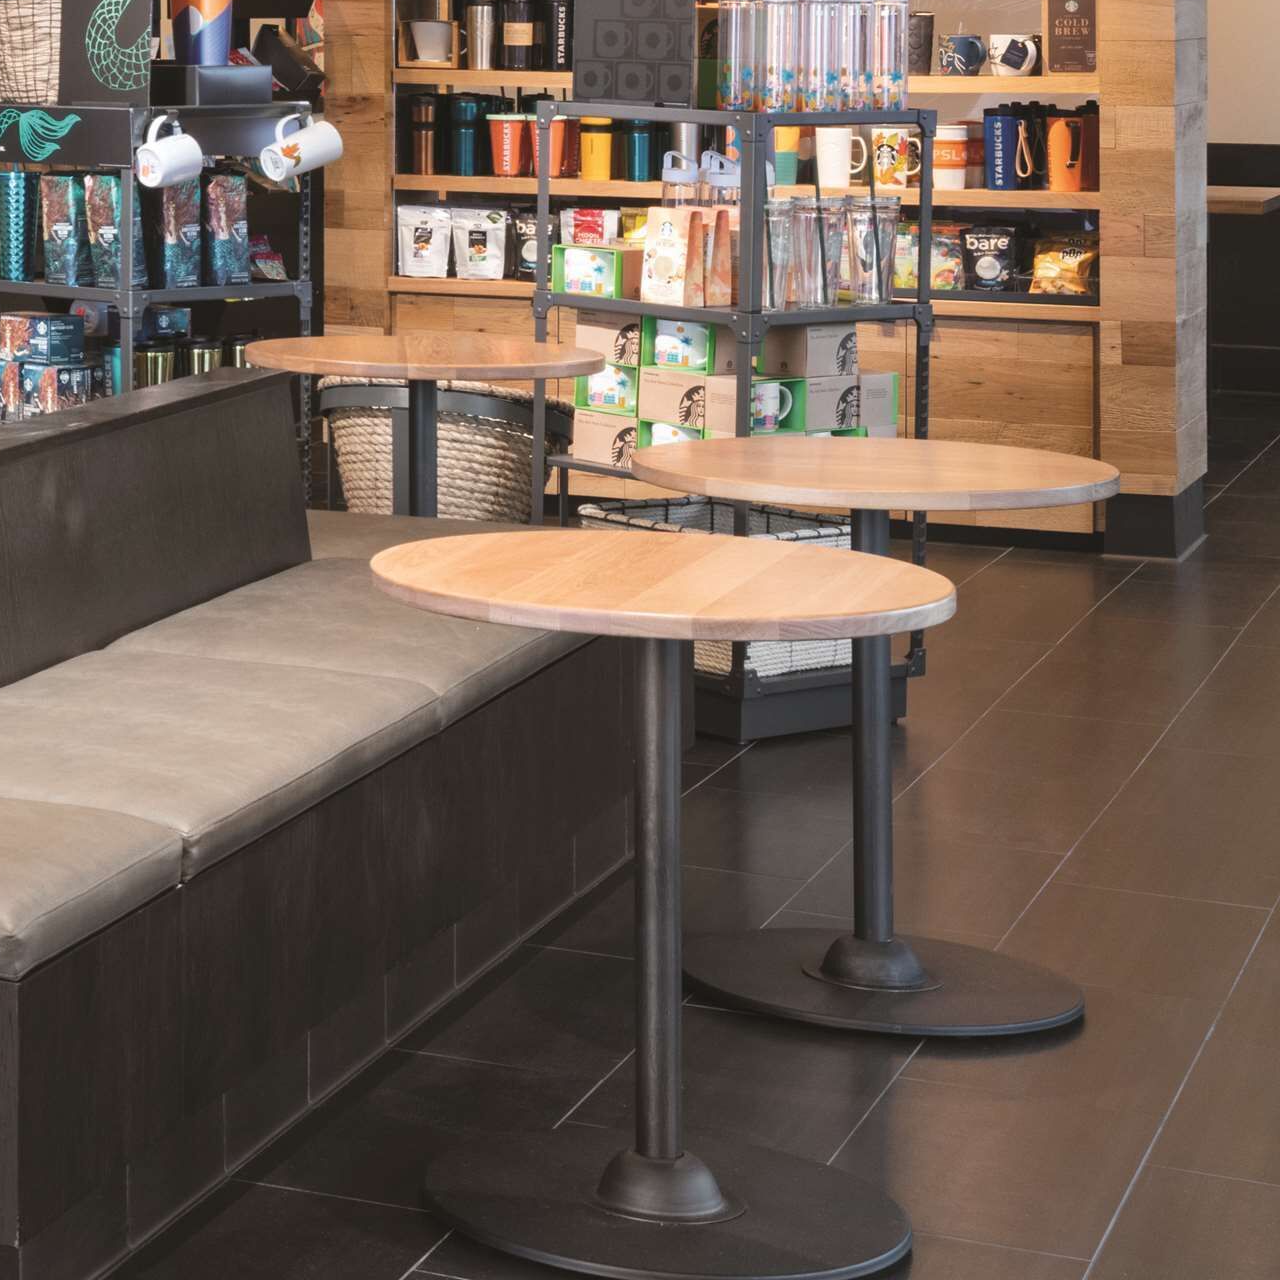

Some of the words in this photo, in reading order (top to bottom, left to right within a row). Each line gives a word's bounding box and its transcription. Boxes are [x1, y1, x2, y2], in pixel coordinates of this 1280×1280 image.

[557, 6, 566, 64] STARBUCKS
[1055, 18, 1089, 27] COLD
[1055, 27, 1090, 36] BREW
[503, 120, 513, 171] STARBUCKS
[995, 121, 1004, 187] STARBUCKS
[965, 234, 1010, 251] bare
